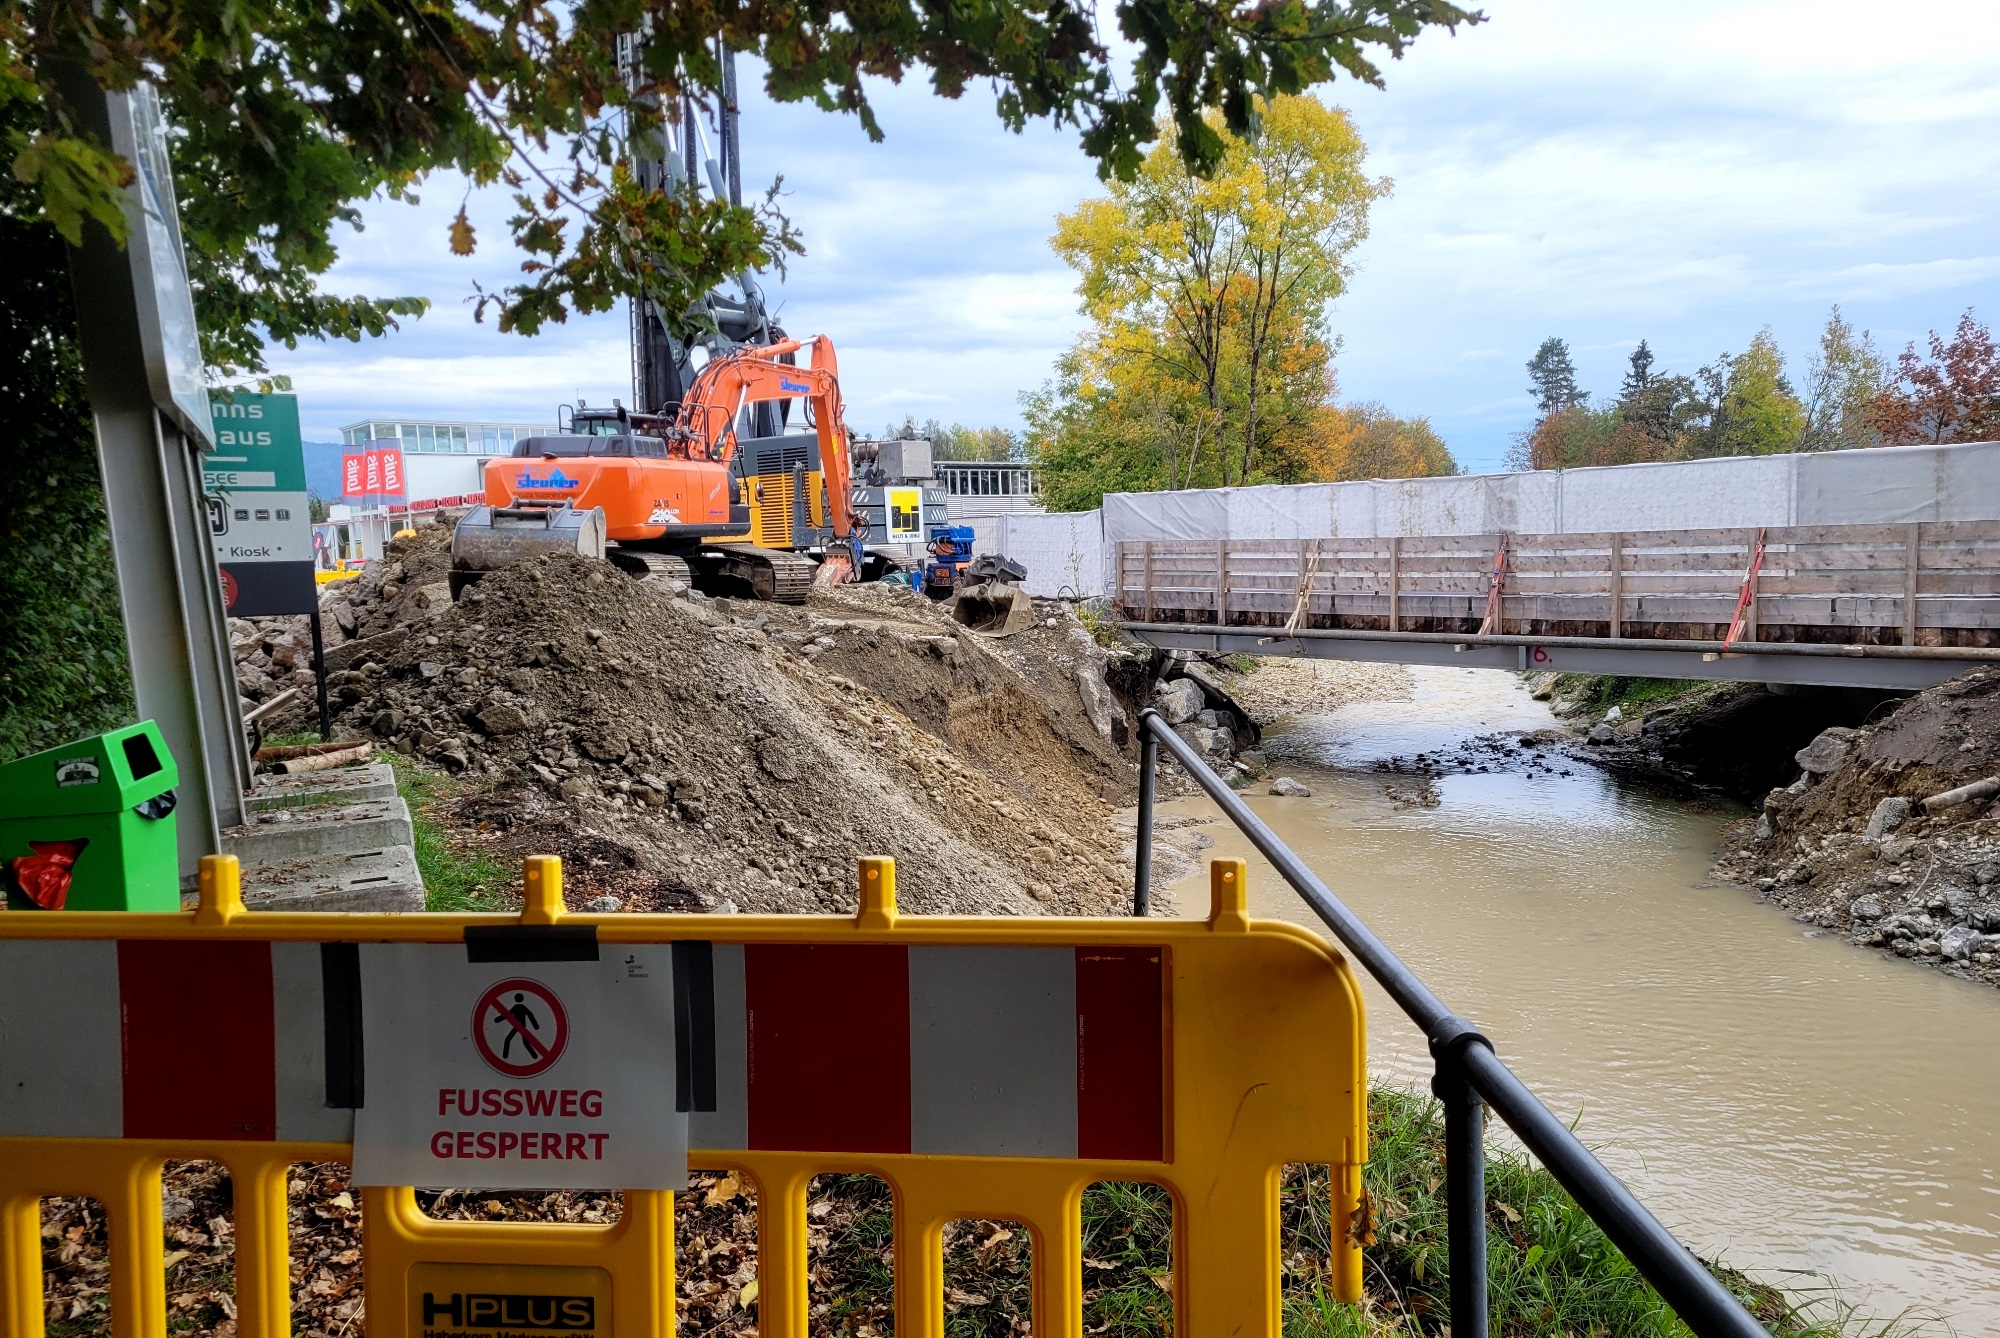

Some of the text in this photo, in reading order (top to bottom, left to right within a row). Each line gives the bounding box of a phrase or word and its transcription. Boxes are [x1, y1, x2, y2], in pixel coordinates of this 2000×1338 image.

[212, 403, 263, 419] nns
[220, 430, 272, 445] aus
[203, 473, 238, 484] SEE
[230, 546, 271, 557] Kiosk
[438, 1087, 603, 1118] FUSSWEG
[430, 1130, 610, 1161] GESPERRT
[423, 1291, 593, 1328] HPLUS
